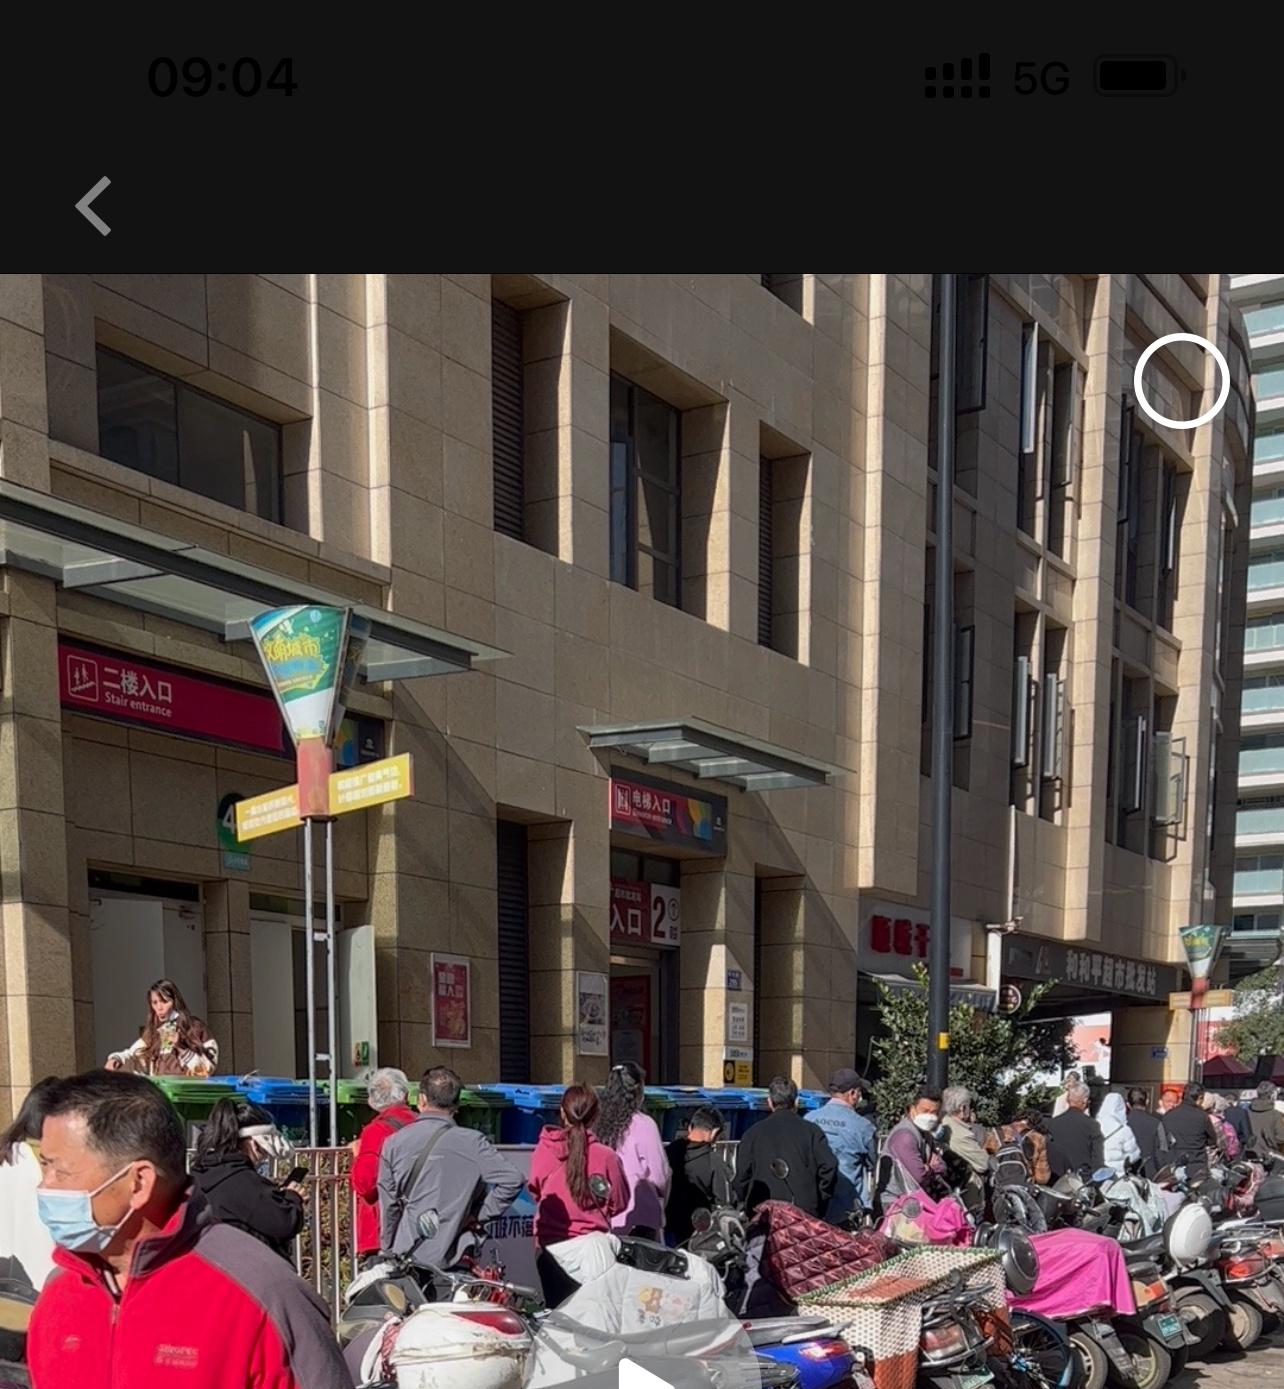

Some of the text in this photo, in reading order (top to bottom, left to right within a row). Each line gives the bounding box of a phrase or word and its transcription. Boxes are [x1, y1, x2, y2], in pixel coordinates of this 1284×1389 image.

[103, 667, 172, 704] 二楼入口
[105, 691, 173, 718] Stair entrance
[632, 789, 671, 815] 电梯入口
[610, 904, 642, 936] 入口
[653, 896, 666, 938] 2
